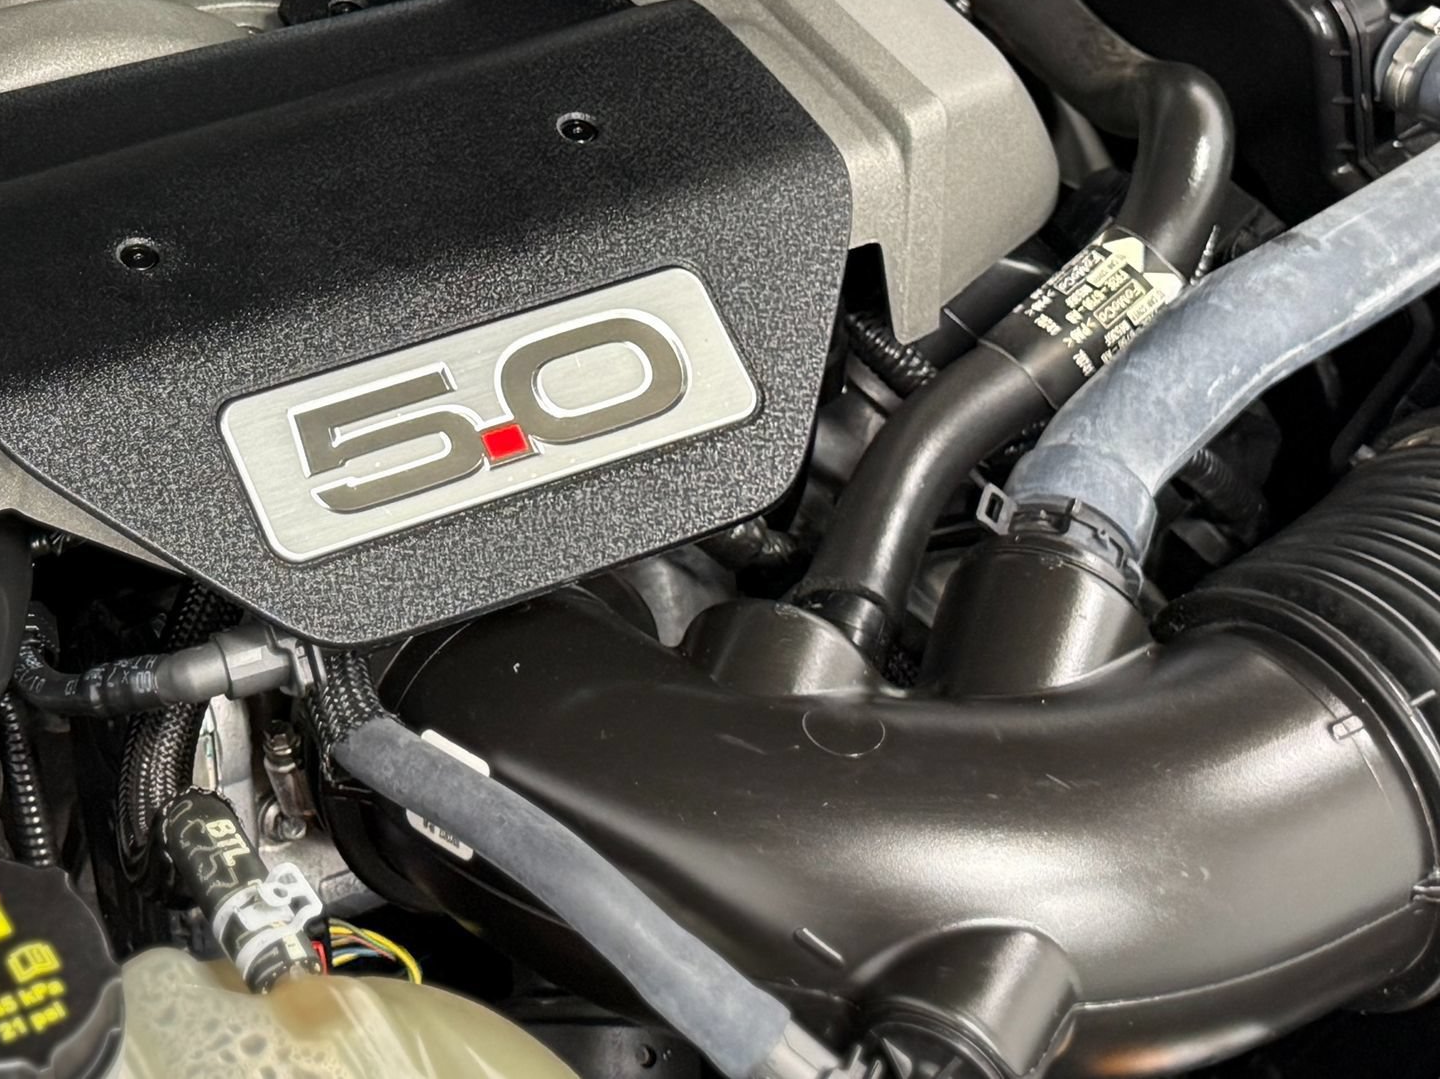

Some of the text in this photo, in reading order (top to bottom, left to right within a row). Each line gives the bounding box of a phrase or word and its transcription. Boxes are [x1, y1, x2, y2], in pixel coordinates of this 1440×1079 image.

[287, 307, 693, 514] 5.0
[205, 818, 251, 867] BTL
[18, 979, 64, 1006] kPa
[29, 1001, 66, 1031] psi
